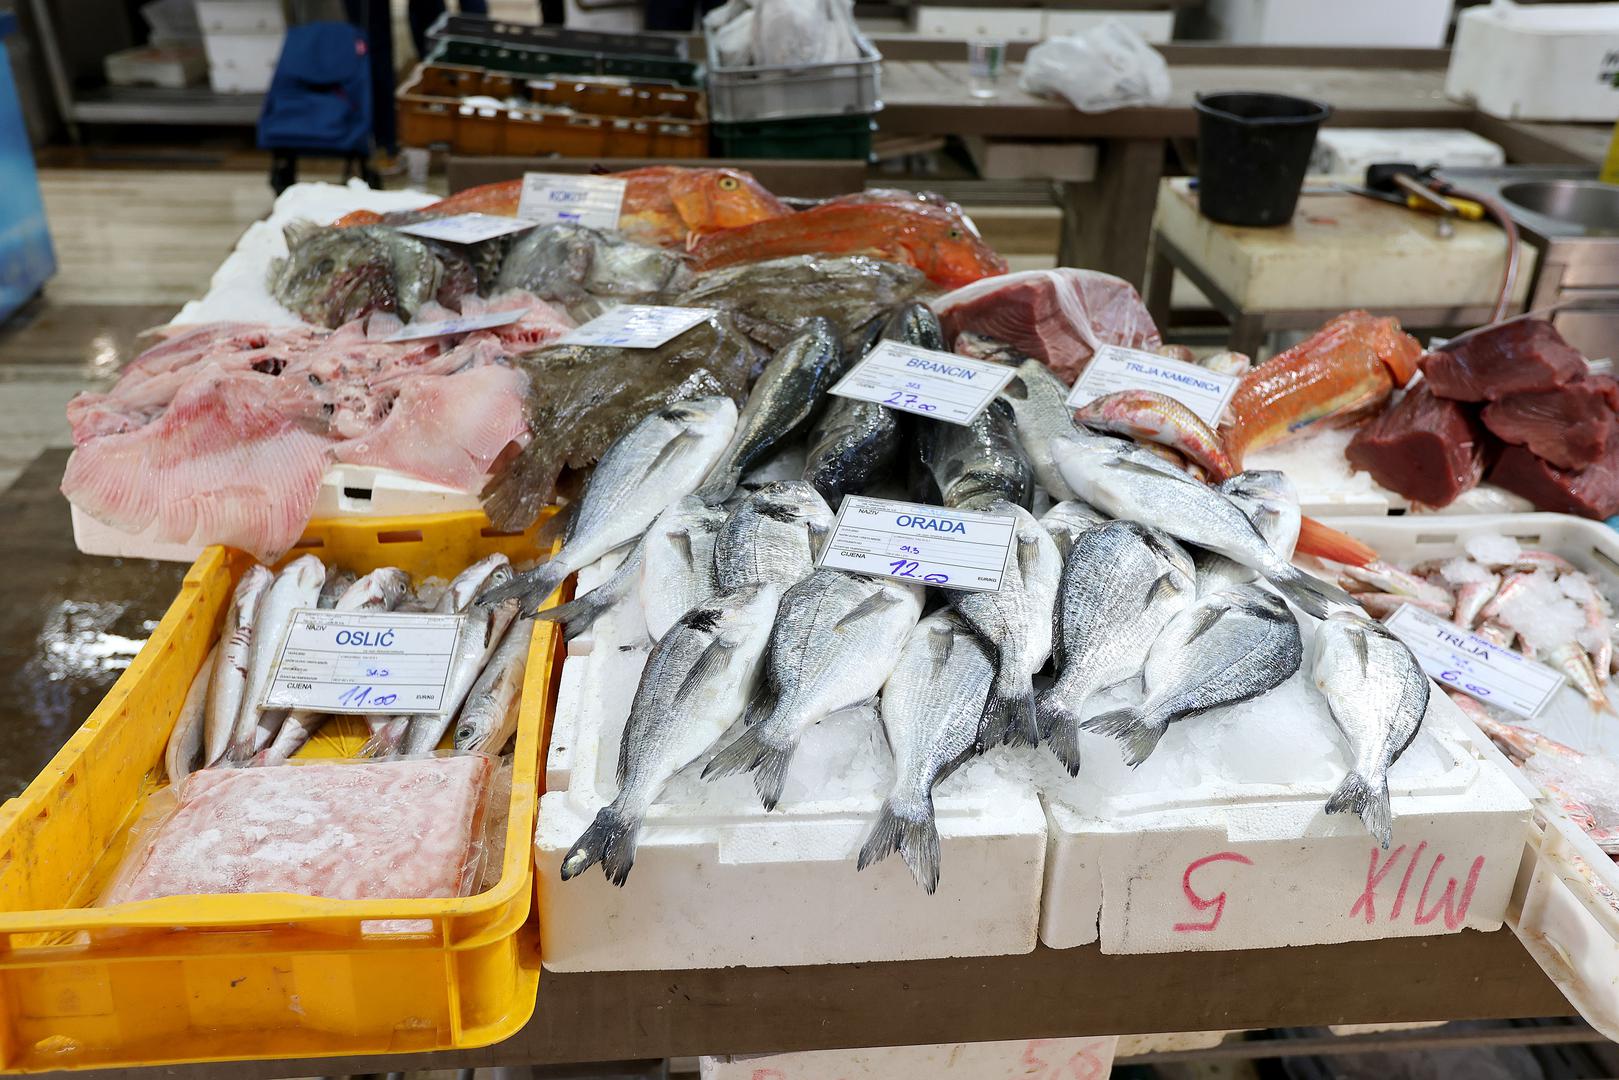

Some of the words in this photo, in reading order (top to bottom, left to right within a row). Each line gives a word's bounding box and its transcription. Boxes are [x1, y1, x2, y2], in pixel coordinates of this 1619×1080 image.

[906, 357, 977, 381] BRANCIN
[1125, 361, 1159, 377] TRLJA
[1160, 371, 1221, 393] KAMENICA
[896, 515, 966, 535] ORADA
[840, 550, 866, 559] CIJENA
[336, 629, 395, 647] OSLIĆ
[1437, 630, 1490, 661] TRLJA
[286, 682, 313, 691] CIJENA
[339, 685, 398, 708] 11.00
[1172, 851, 1254, 933] 5
[1350, 840, 1486, 931] MIX
